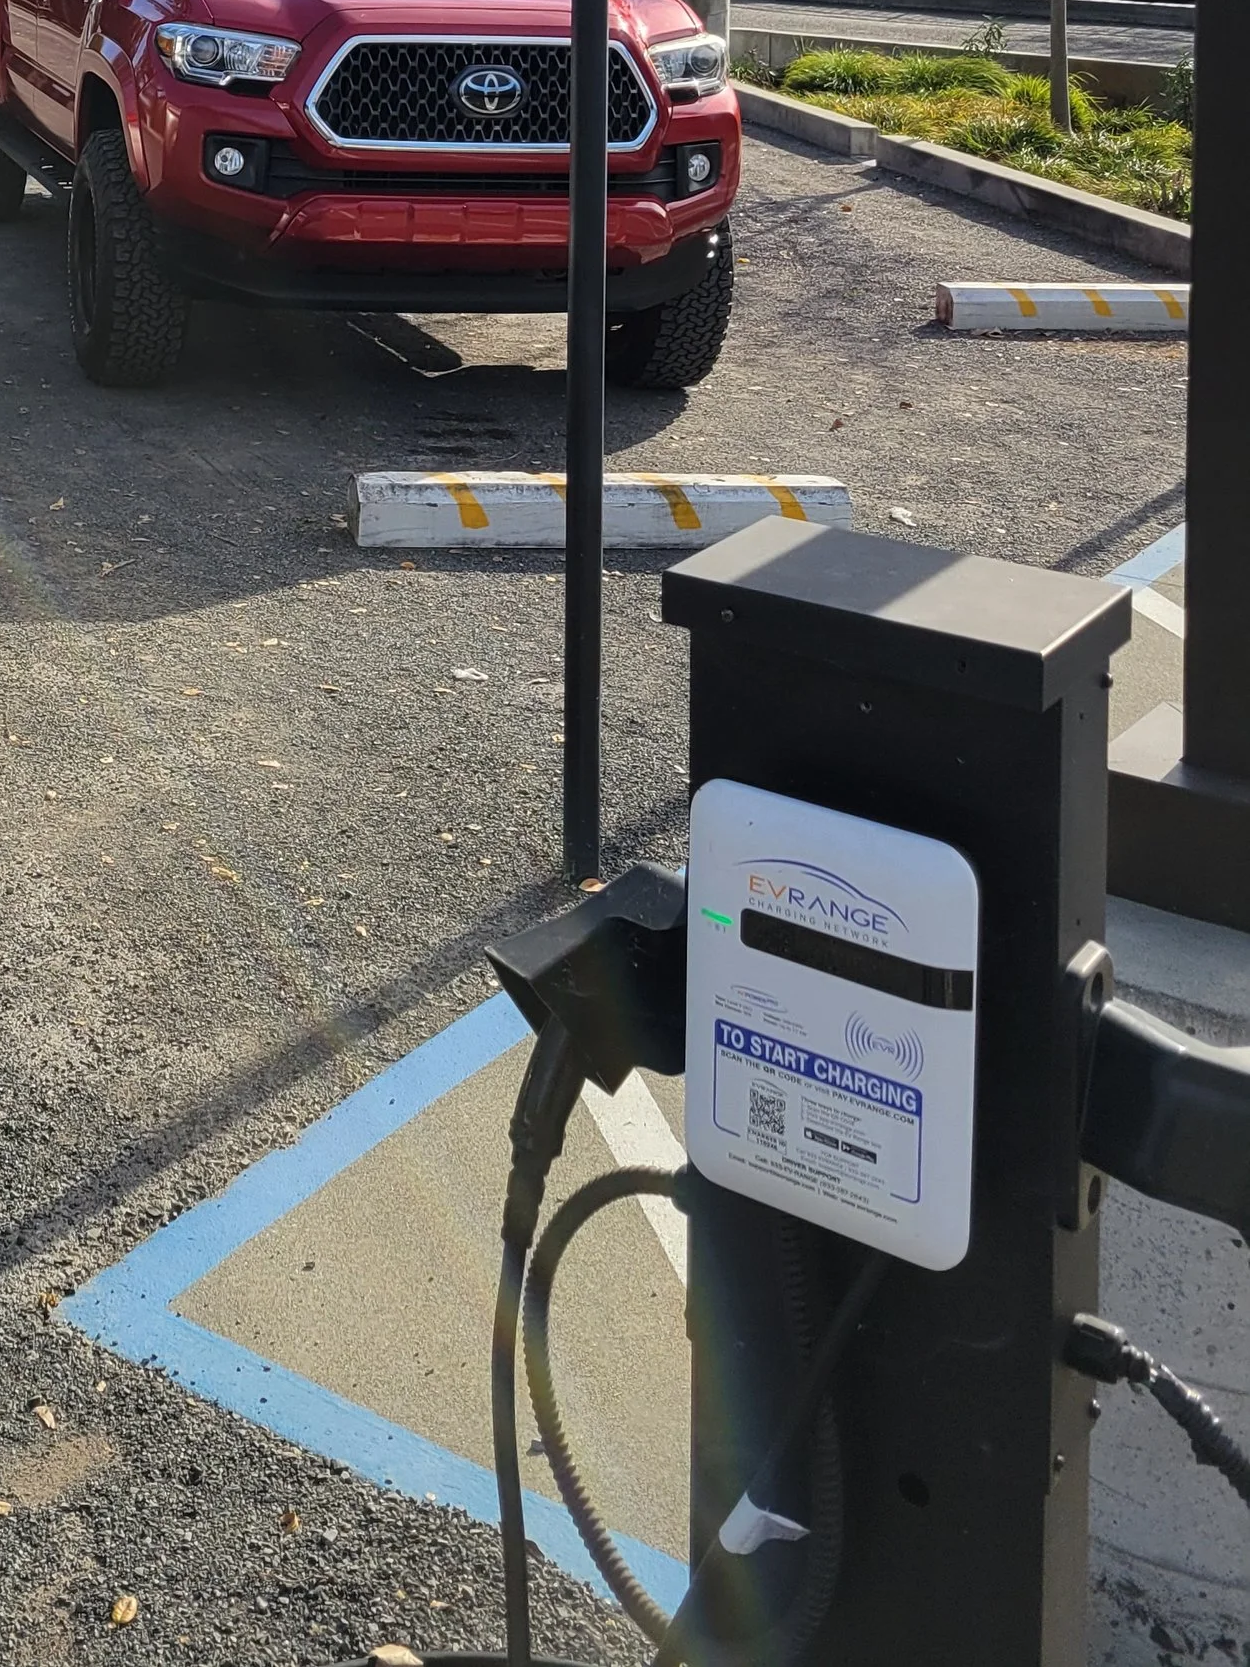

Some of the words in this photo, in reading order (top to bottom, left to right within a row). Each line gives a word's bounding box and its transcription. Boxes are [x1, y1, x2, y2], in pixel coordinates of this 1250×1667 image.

[748, 897, 817, 925] CHARGING
[823, 920, 890, 948] NETWORK
[749, 874, 889, 935] EVRANGE
[719, 1021, 745, 1049] TO
[750, 1034, 809, 1073] START
[813, 1058, 917, 1113] CHARGING
[720, 1049, 742, 1064] SCAN
[745, 1058, 761, 1070] THE
[763, 1065, 776, 1076] QR
[778, 1071, 802, 1085] CODE
